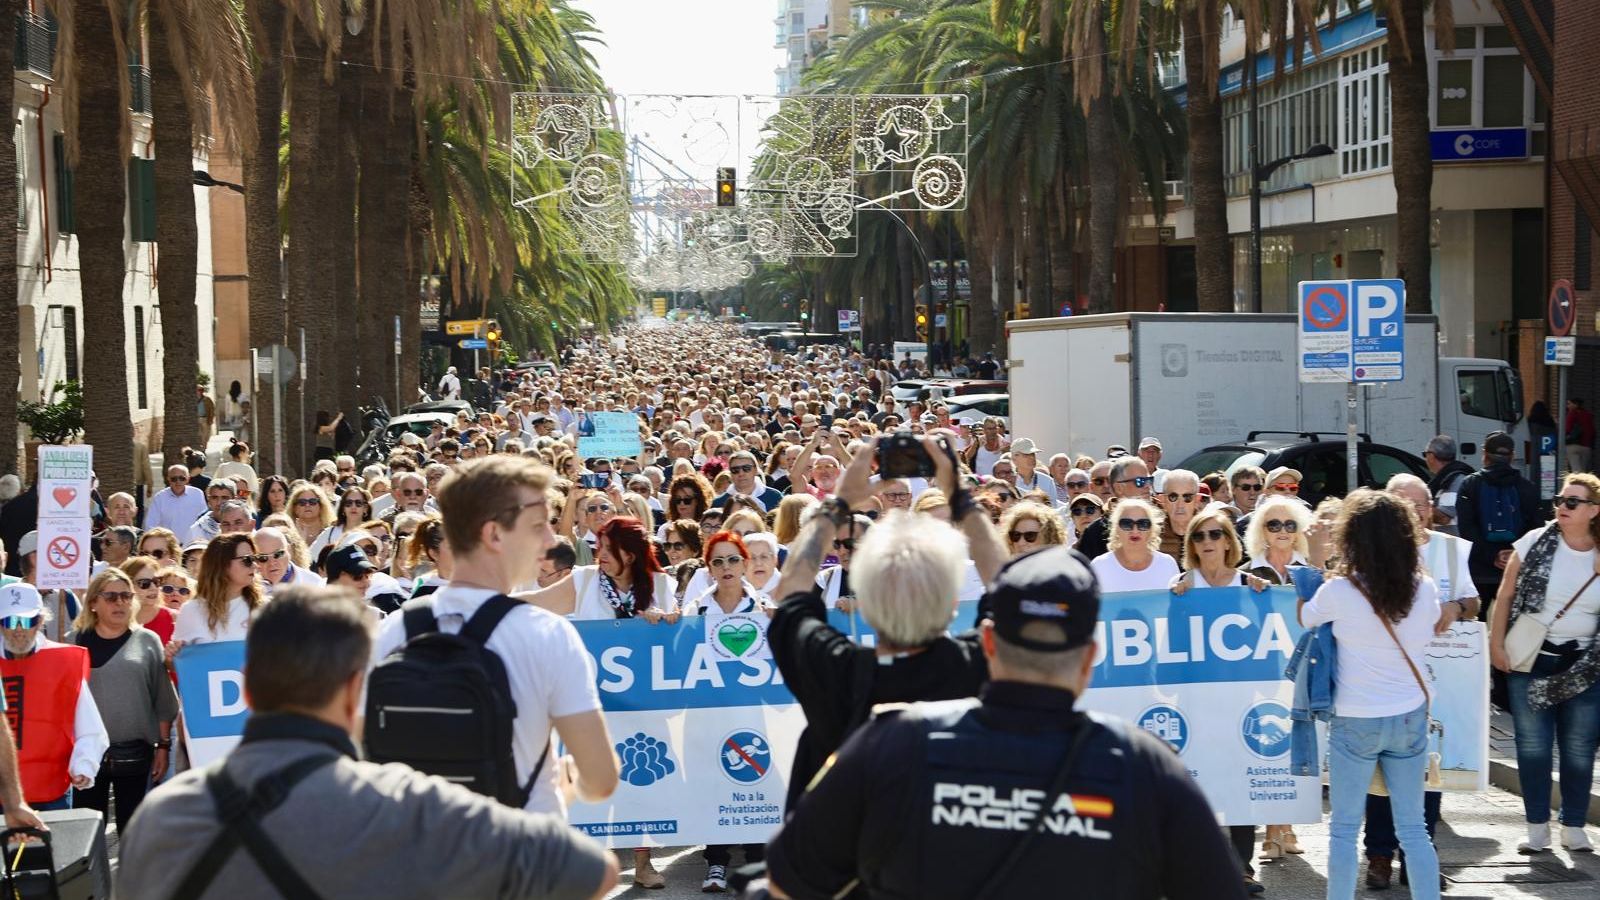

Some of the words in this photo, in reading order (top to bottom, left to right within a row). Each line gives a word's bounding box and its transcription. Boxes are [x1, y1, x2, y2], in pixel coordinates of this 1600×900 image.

[1357, 285, 1398, 337] P
[1195, 350, 1239, 362] Tiendas
[1240, 350, 1284, 362] DIGITAL
[1542, 436, 1552, 450] P
[651, 643, 726, 690] LA
[1246, 766, 1291, 776] Asistenc
[1249, 778, 1296, 788] Sanitaria
[732, 792, 746, 802] No
[749, 793, 754, 801] a
[756, 791, 765, 801] la
[933, 782, 1077, 816] POLICA
[1249, 790, 1297, 801] Universal
[719, 803, 780, 815] Privatización
[718, 816, 730, 826] de
[732, 816, 741, 826] la
[743, 815, 781, 825] Sanidad
[591, 824, 634, 834] SANIDAD
[635, 822, 675, 832] PÚBLICA
